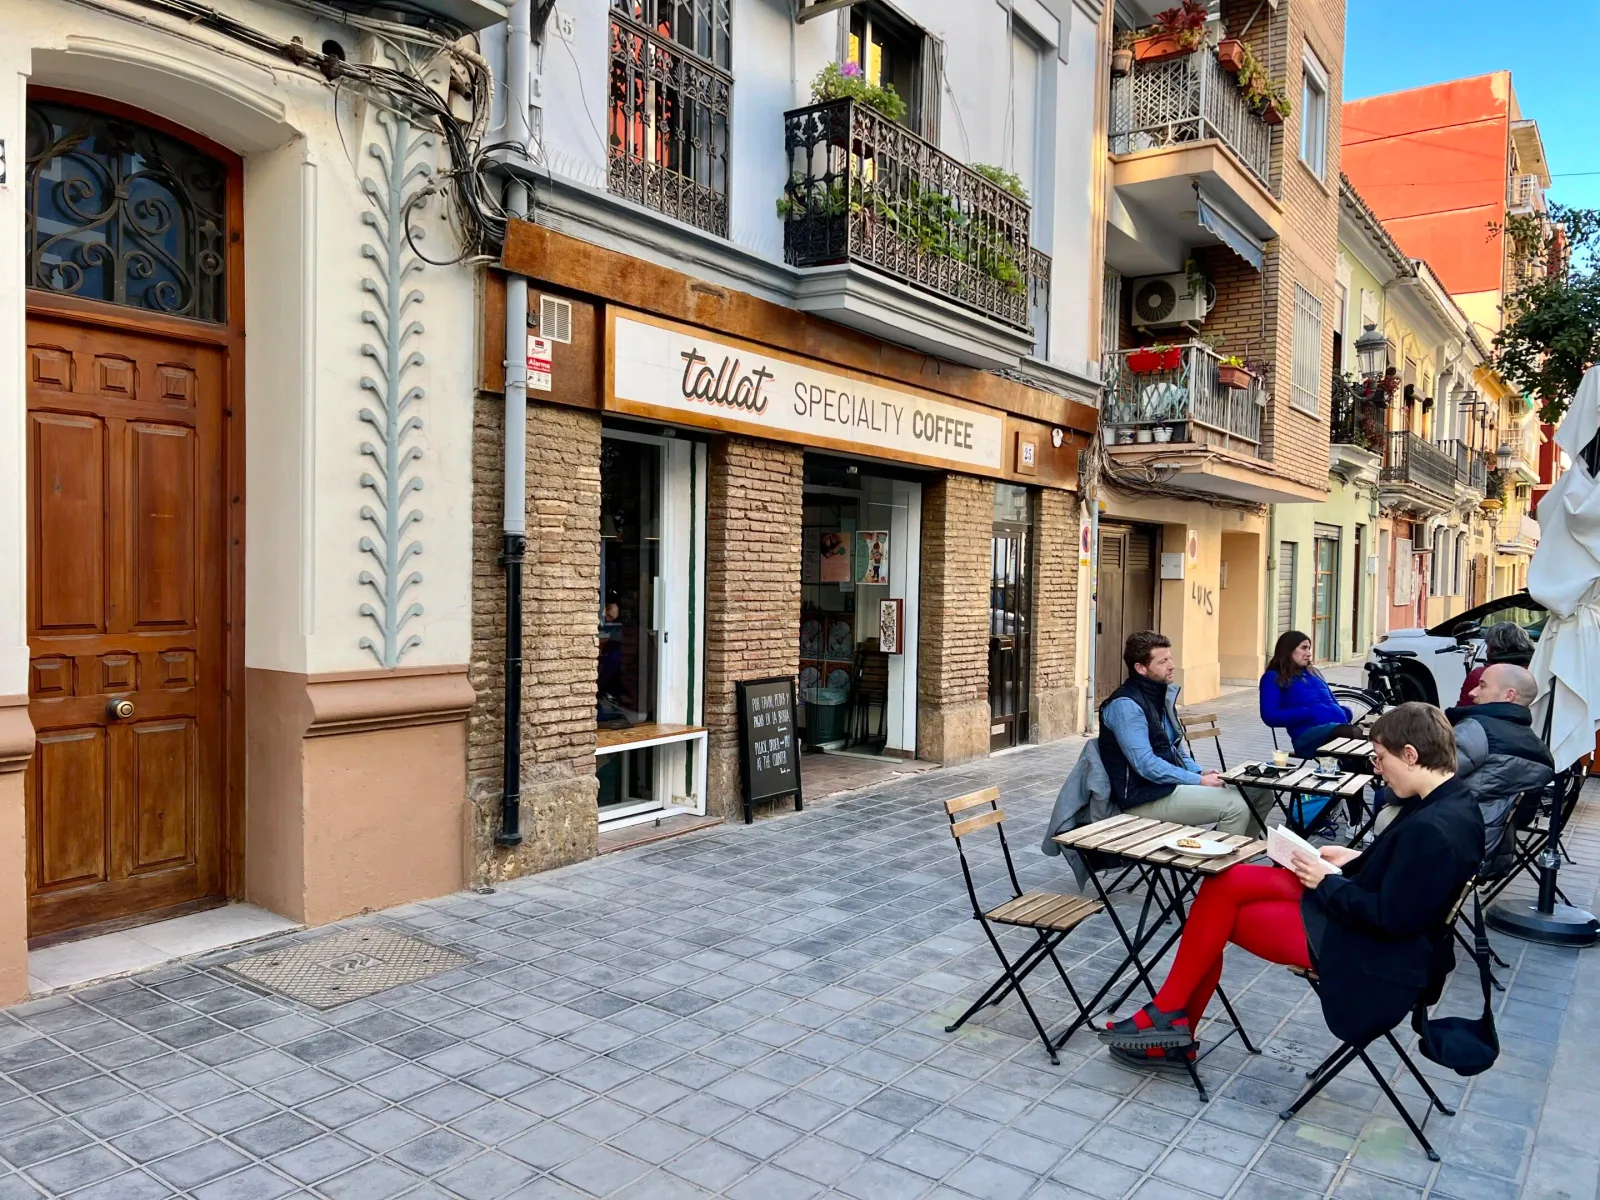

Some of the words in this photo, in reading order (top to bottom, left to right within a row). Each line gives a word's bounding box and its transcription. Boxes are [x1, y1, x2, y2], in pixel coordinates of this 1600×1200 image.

[529, 359, 550, 369] Alarma
[680, 347, 775, 415] tallat
[793, 381, 904, 435] SPECIALTY
[912, 409, 974, 450] COFFEE
